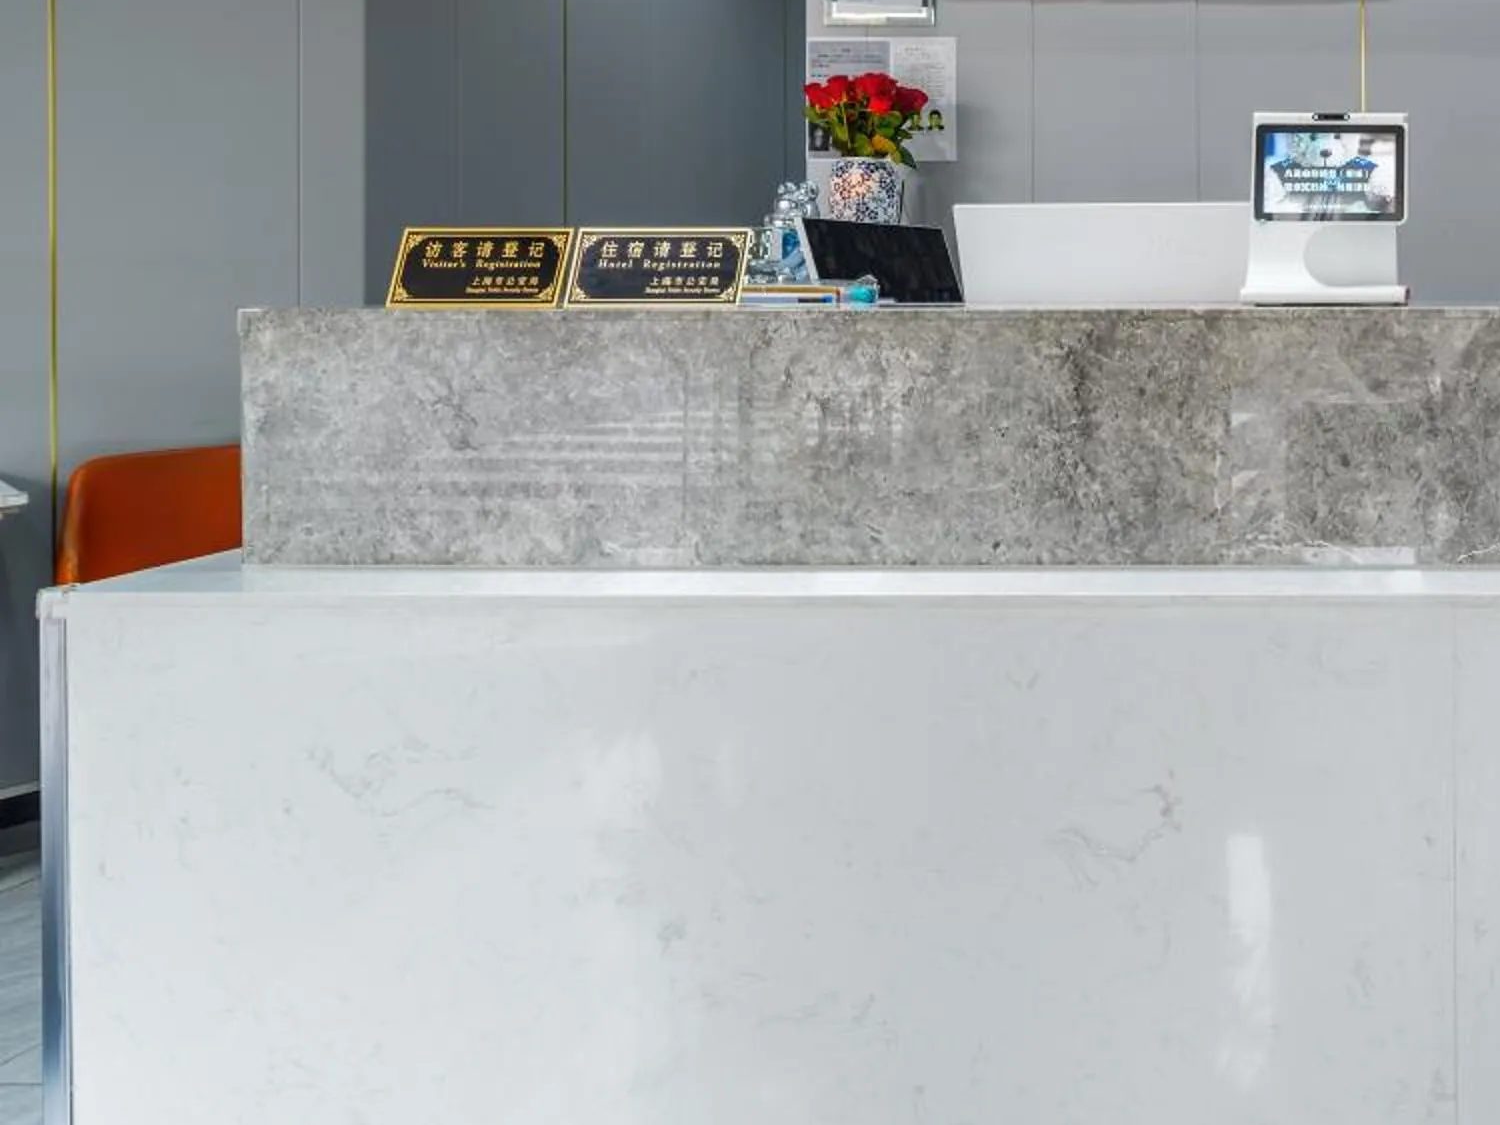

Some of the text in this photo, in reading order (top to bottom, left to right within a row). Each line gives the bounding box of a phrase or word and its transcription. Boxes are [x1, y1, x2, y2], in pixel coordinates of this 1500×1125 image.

[424, 240, 545, 258] 访客请登记
[600, 240, 723, 258] 住宿请登记
[475, 258, 541, 271] Registration
[643, 258, 721, 272] Registration
